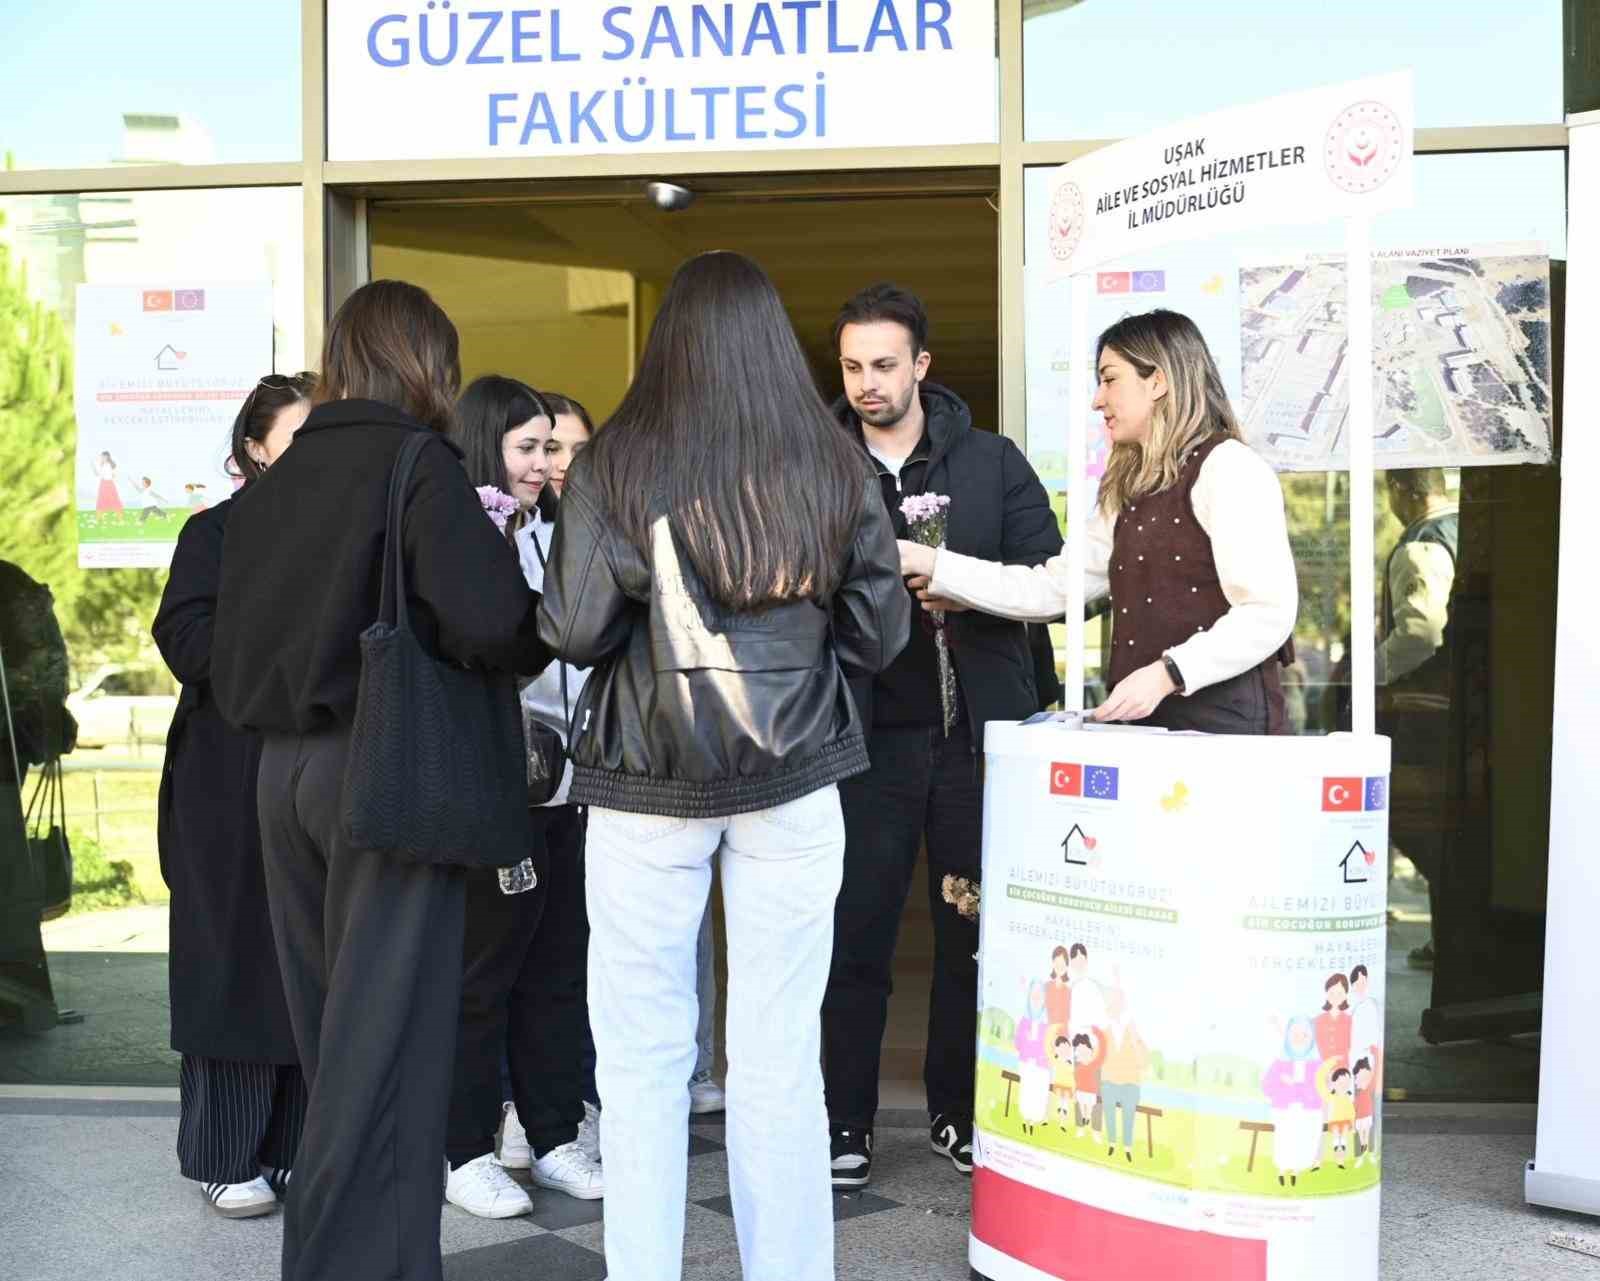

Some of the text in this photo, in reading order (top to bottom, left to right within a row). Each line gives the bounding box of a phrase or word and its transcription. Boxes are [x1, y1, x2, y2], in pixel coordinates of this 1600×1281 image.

[367, 0, 954, 67] GÜZEL SANATLAR
[488, 71, 826, 146] FAKÜLTESİ
[1096, 145, 1305, 215] AİLE VE SOSYAL HİZMETLER
[1164, 138, 1206, 166] UŞAK
[1128, 180, 1245, 230] İL MÜDÜRLÜĞÜ
